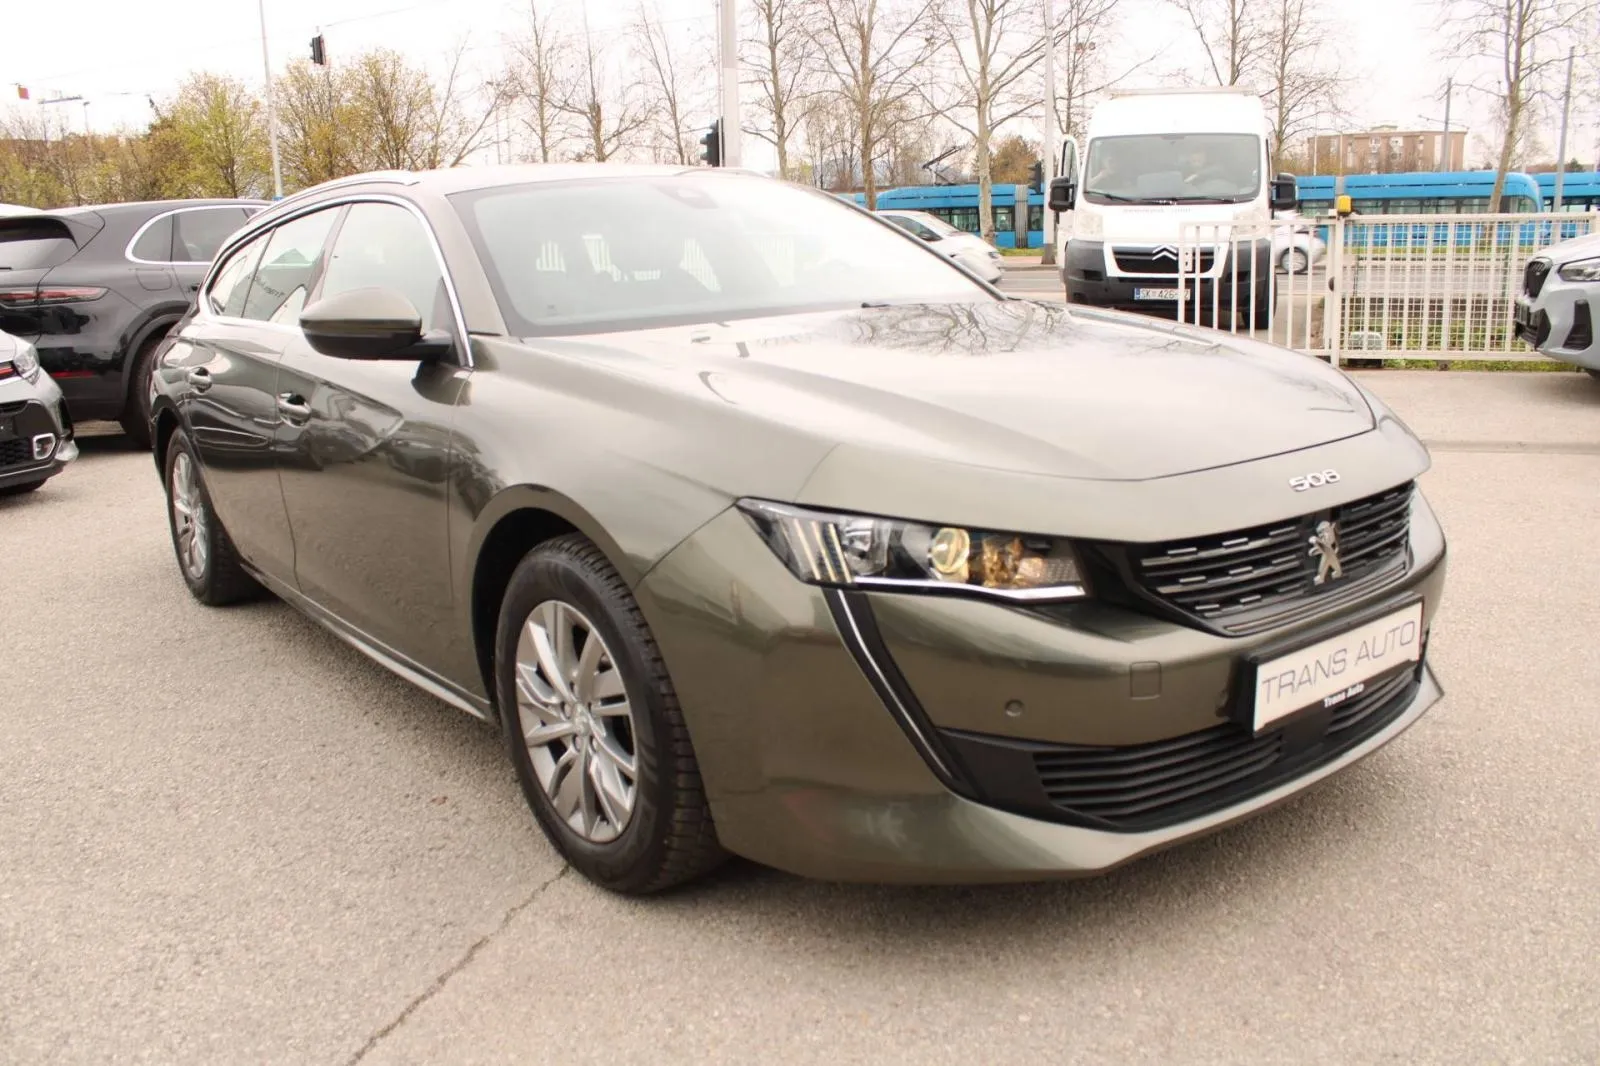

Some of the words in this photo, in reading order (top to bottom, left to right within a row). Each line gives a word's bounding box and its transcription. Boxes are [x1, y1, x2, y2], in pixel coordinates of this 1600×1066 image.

[1288, 468, 1341, 492] 508
[1261, 647, 1348, 705] TRANS
[1355, 620, 1416, 667] AUTO
